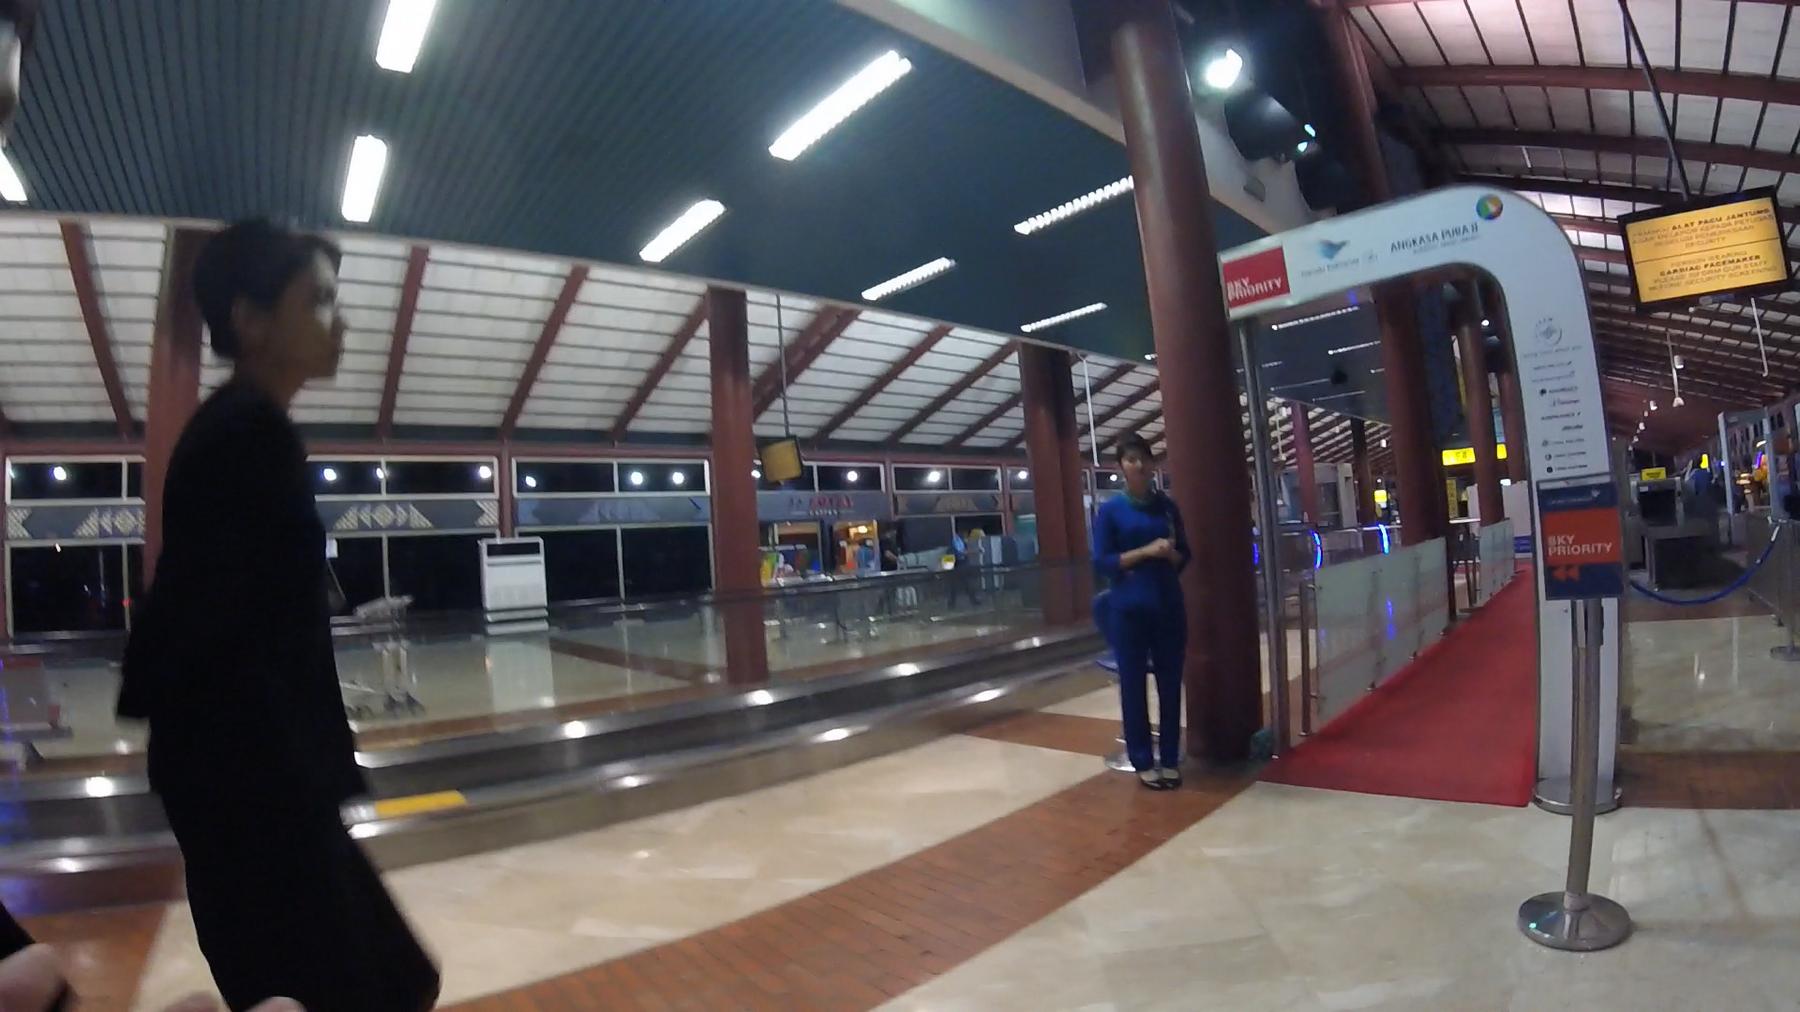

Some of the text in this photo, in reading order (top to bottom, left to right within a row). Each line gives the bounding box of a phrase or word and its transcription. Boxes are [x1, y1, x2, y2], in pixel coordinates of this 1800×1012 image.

[1698, 216, 1722, 225] PACU
[1659, 254, 1761, 276] CARDIAC PACEMAKER
[1548, 542, 1612, 557] PRIORITY
